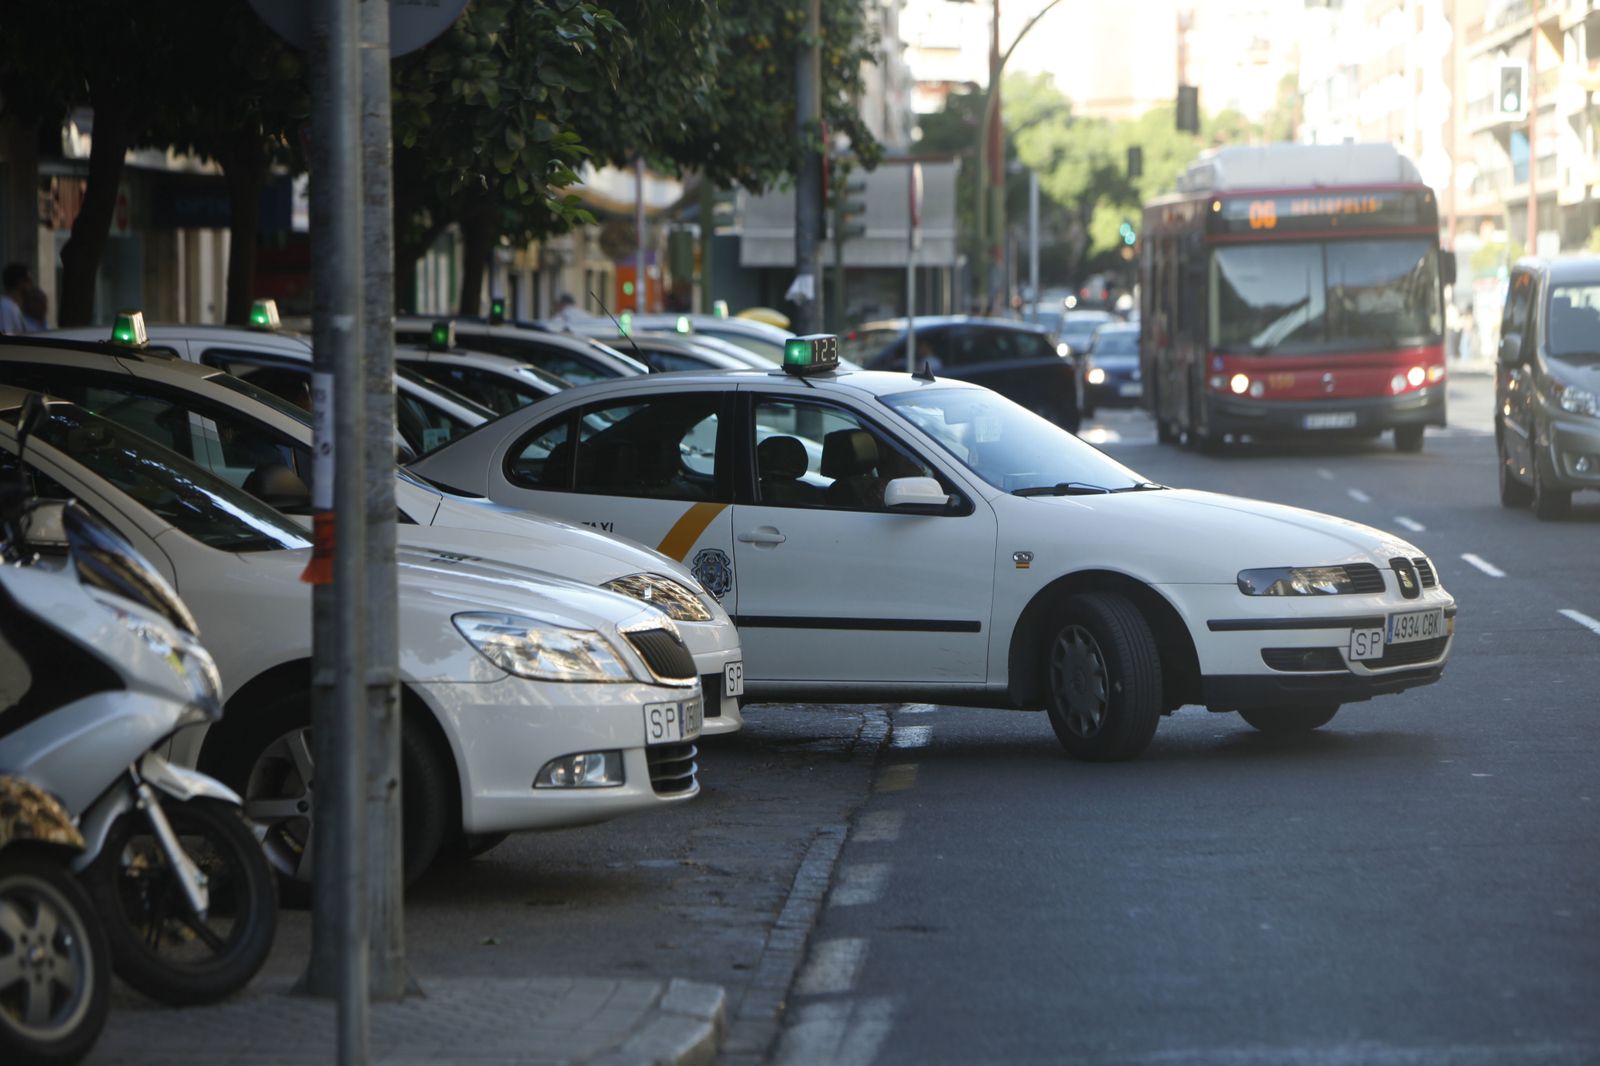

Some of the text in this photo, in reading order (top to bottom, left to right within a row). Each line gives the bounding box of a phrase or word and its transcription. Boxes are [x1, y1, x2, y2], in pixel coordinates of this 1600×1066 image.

[1249, 200, 1277, 229] 06
[814, 338, 837, 362] 123
[1394, 612, 1440, 640] 4934 CBK
[1355, 631, 1381, 656] SP
[728, 666, 742, 692] SP
[650, 707, 676, 739] SP
